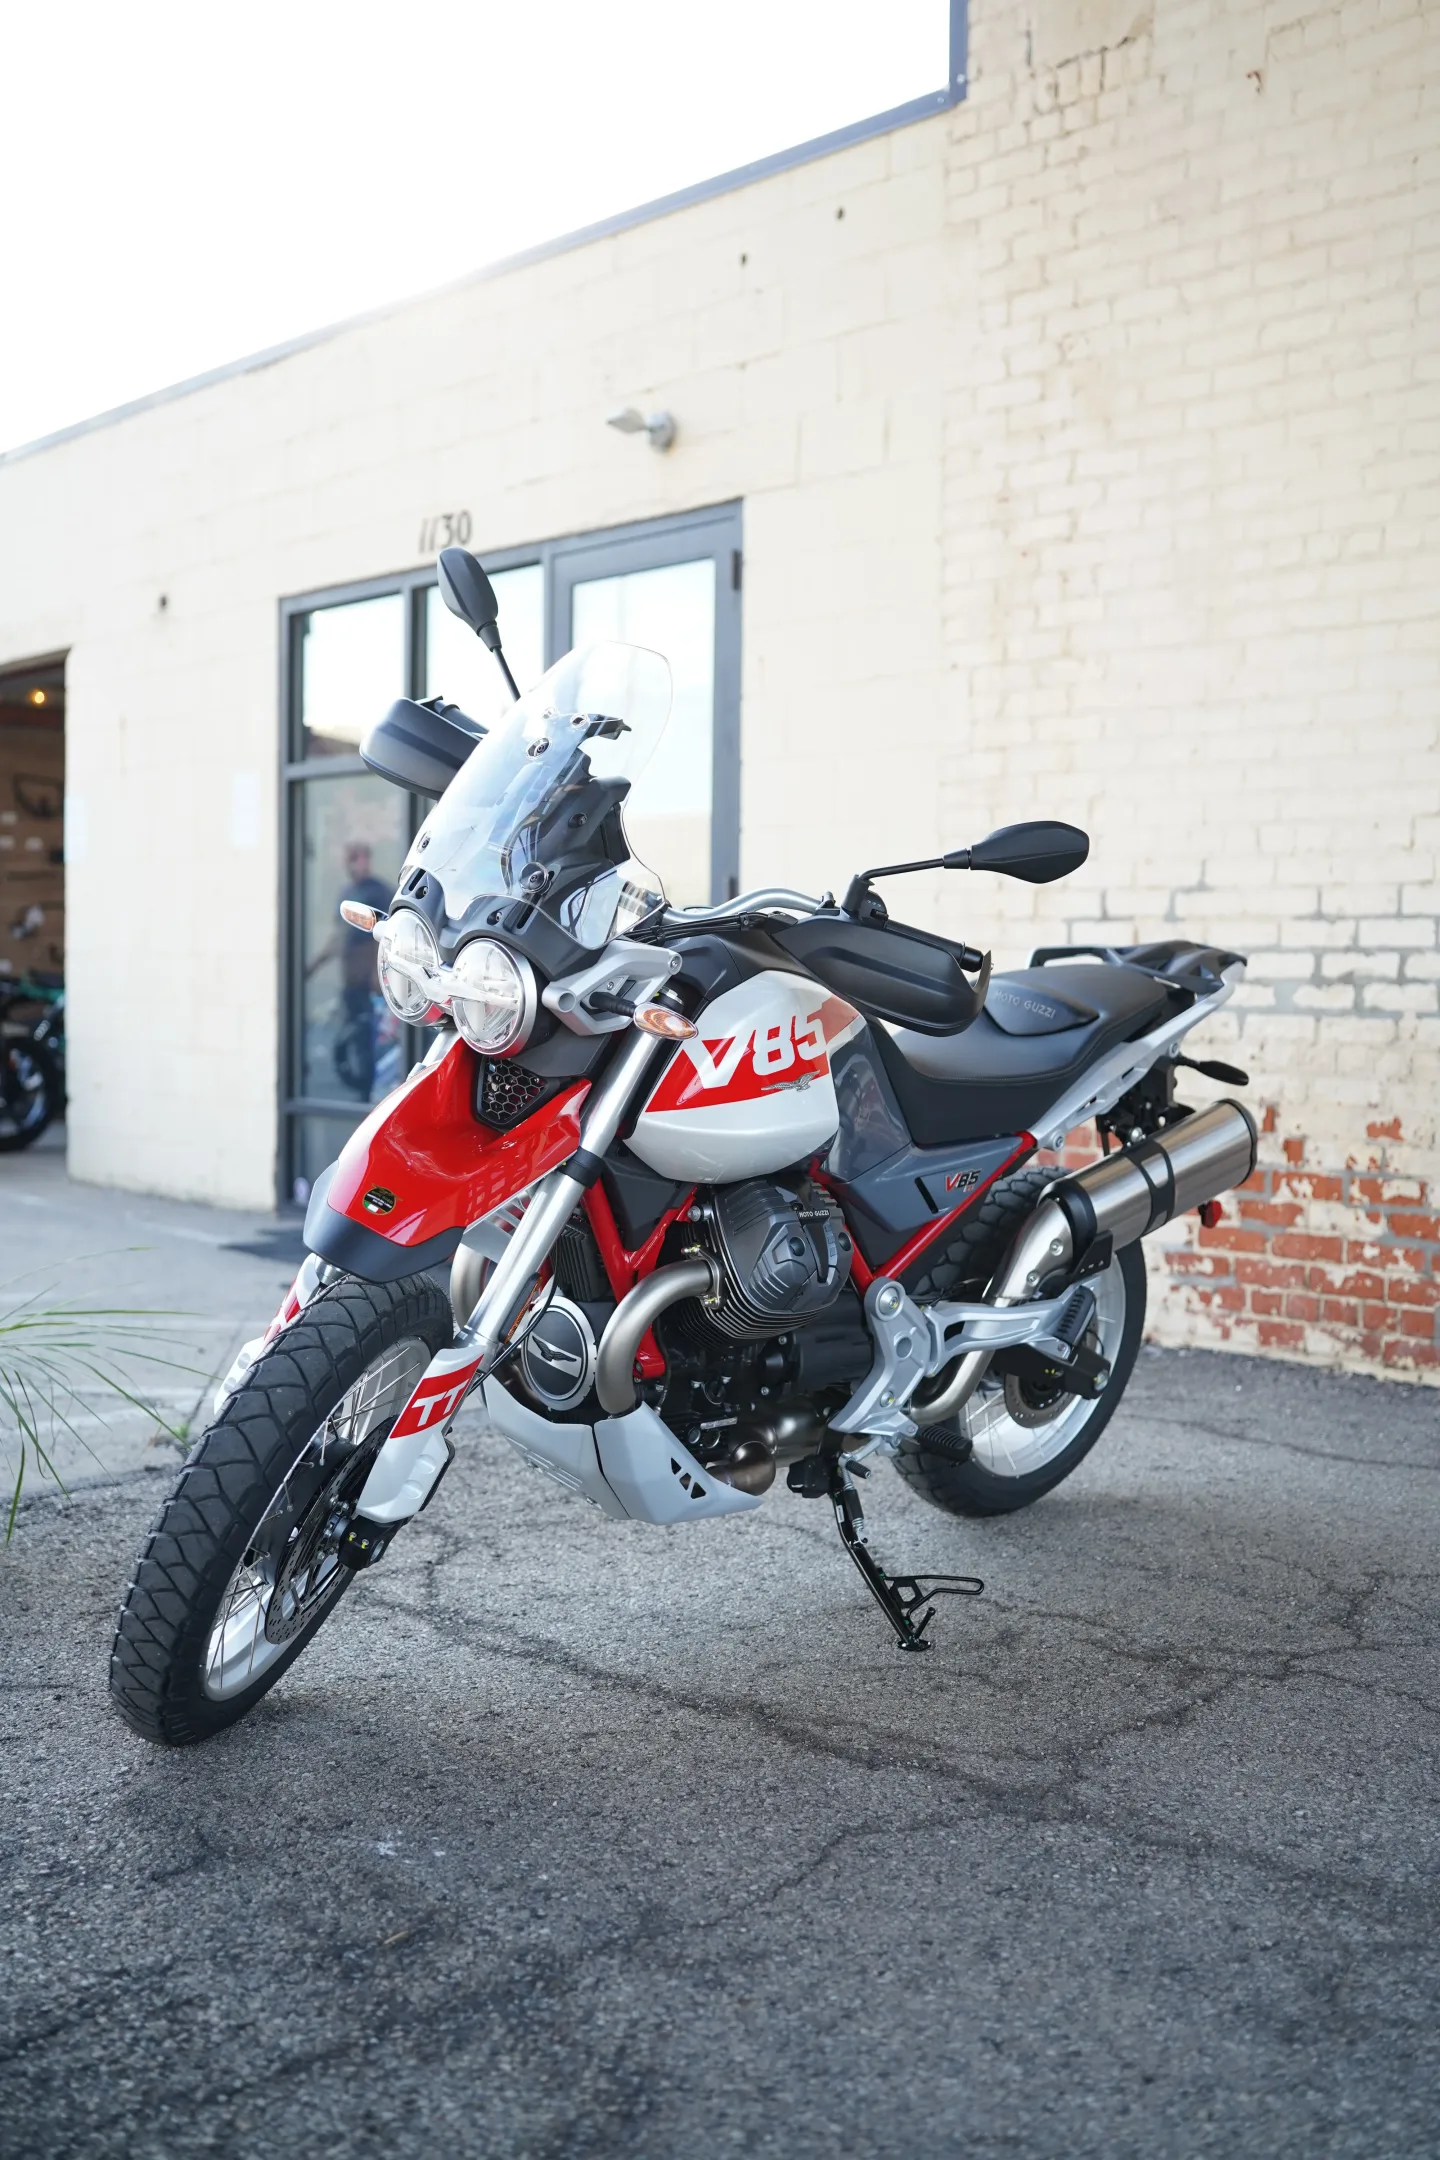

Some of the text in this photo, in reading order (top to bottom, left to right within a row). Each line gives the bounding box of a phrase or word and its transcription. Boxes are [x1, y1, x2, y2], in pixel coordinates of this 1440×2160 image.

[419, 509, 473, 553] 1130
[994, 990, 1057, 1020] MOTO GUZZI
[683, 1003, 828, 1090] V85
[945, 1170, 981, 1192] V85
[814, 1209, 830, 1217] GUZZI
[411, 1378, 470, 1428] TT
